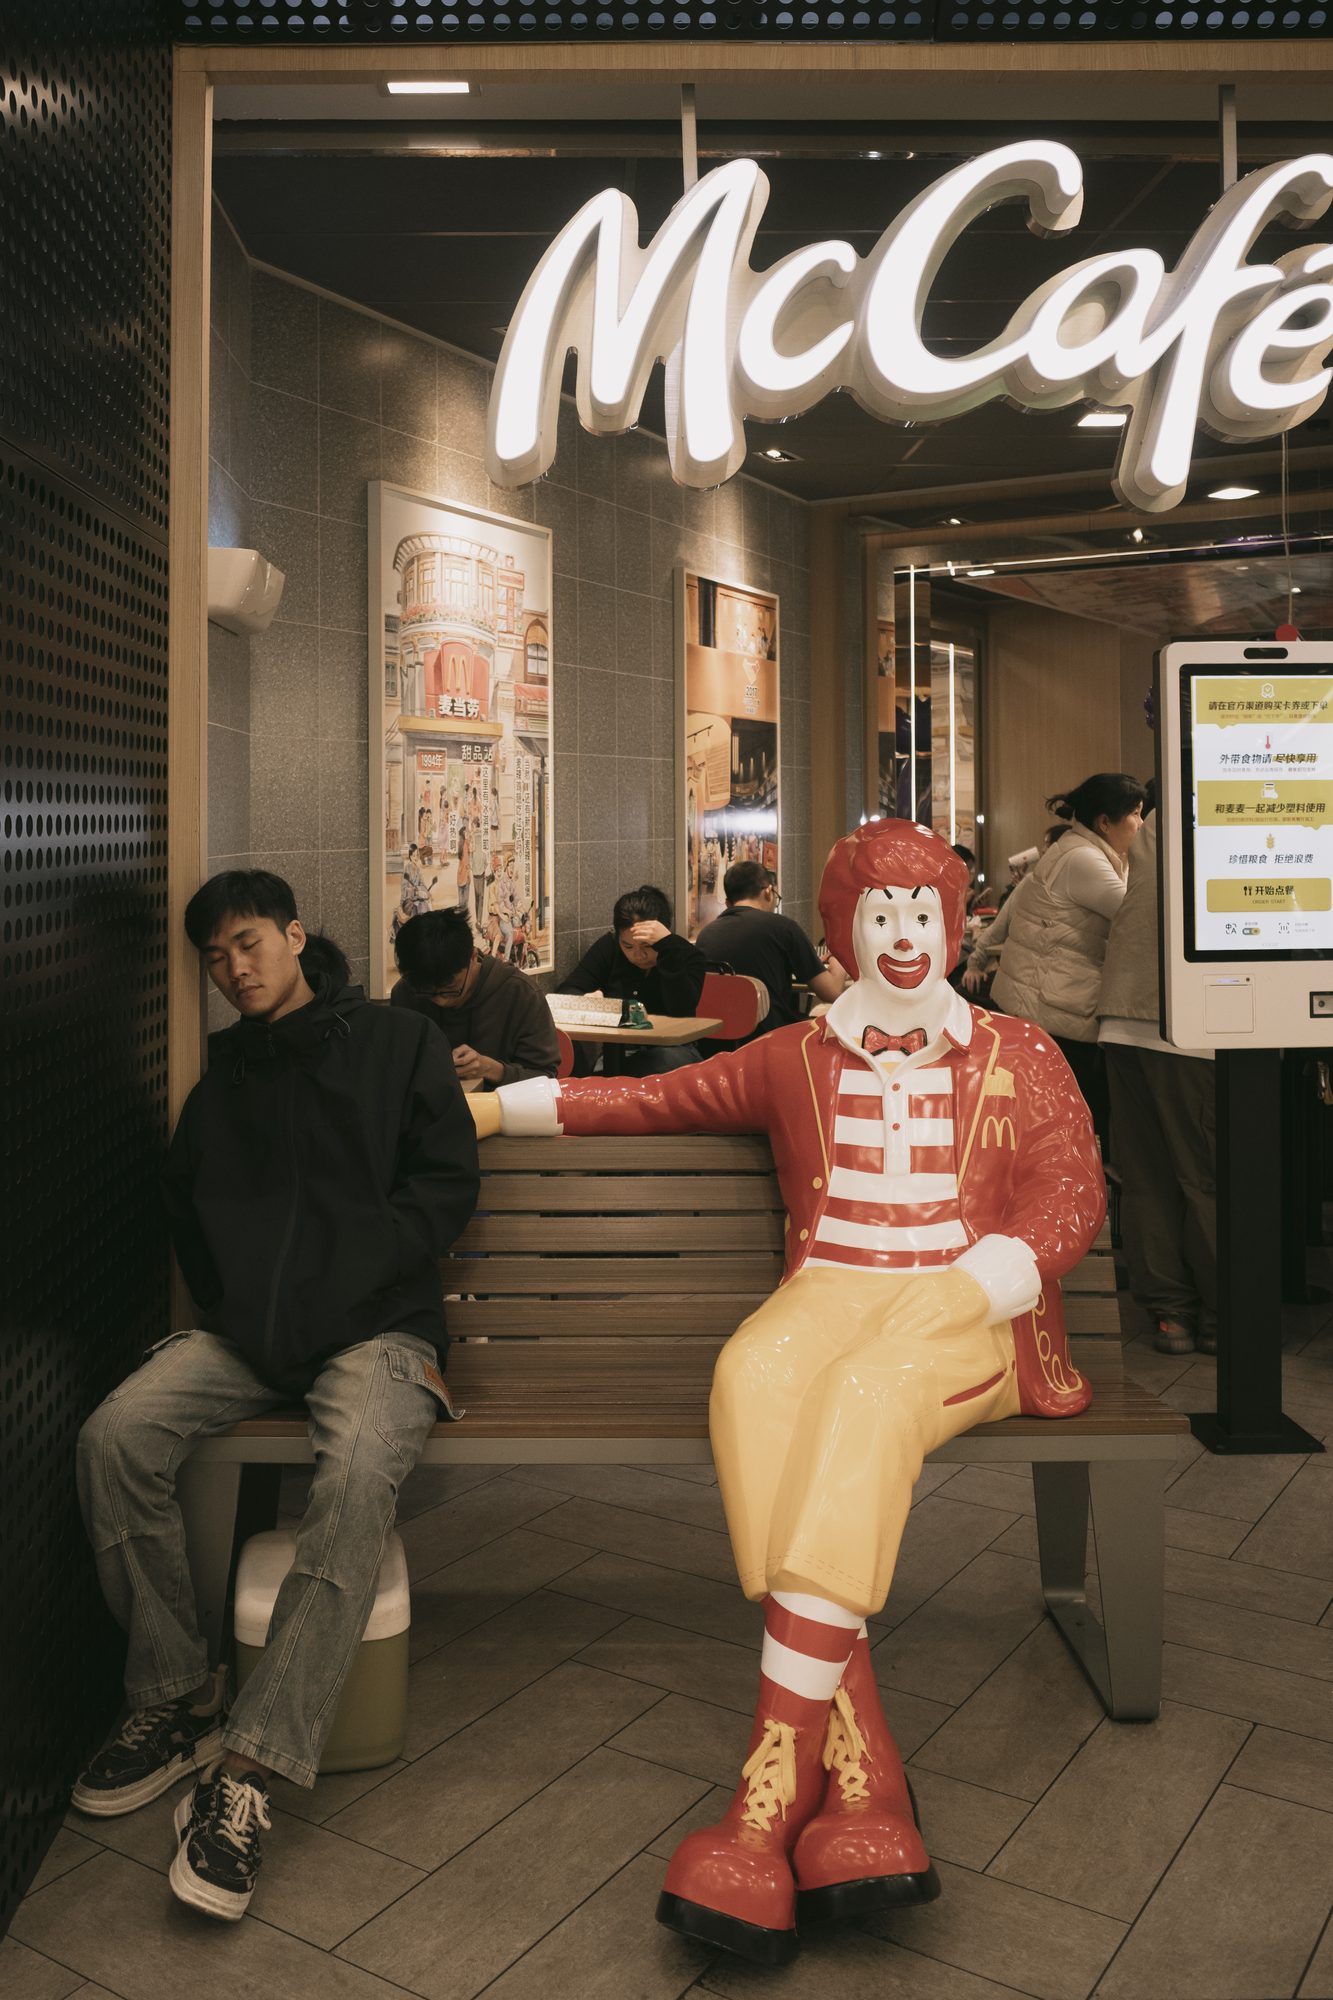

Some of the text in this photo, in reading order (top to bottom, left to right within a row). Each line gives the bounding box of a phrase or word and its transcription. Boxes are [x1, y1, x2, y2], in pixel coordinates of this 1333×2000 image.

[492, 139, 1333, 491] McCafé
[439, 695, 480, 718] 麦当劳
[1208, 701, 1329, 711] 请在官方渠道购买卡券或下单
[462, 745, 493, 761] 甜品站
[1220, 753, 1317, 764] 外带食物请 尽快享用
[421, 754, 443, 768] 1994年
[1215, 803, 1327, 814] 和麦麦一起减少塑料使用
[1228, 854, 1314, 864] 珍惜粮食 拒绝浪费
[1255, 885, 1295, 896] 开始点餐
